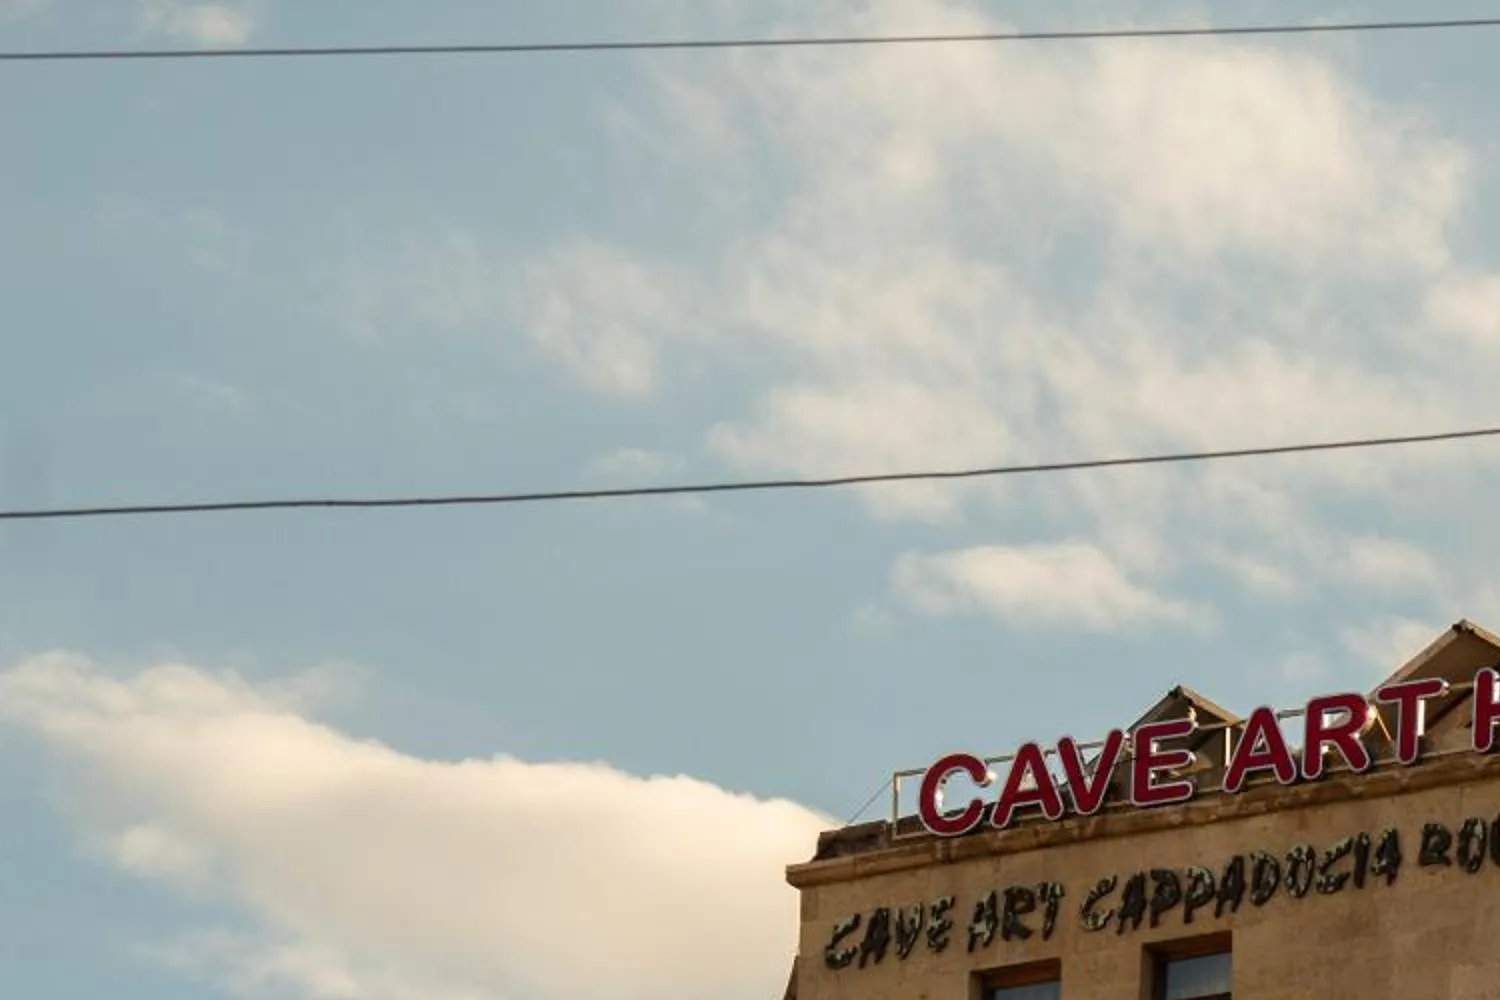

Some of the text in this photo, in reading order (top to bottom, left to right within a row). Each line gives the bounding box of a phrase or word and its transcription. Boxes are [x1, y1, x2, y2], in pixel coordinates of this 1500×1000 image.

[918, 720, 1197, 837] CAVE
[1222, 677, 1449, 794] ART
[824, 895, 955, 971] CAVE
[967, 880, 1066, 955] ART
[1080, 824, 1402, 935] CAPPADOCIA
